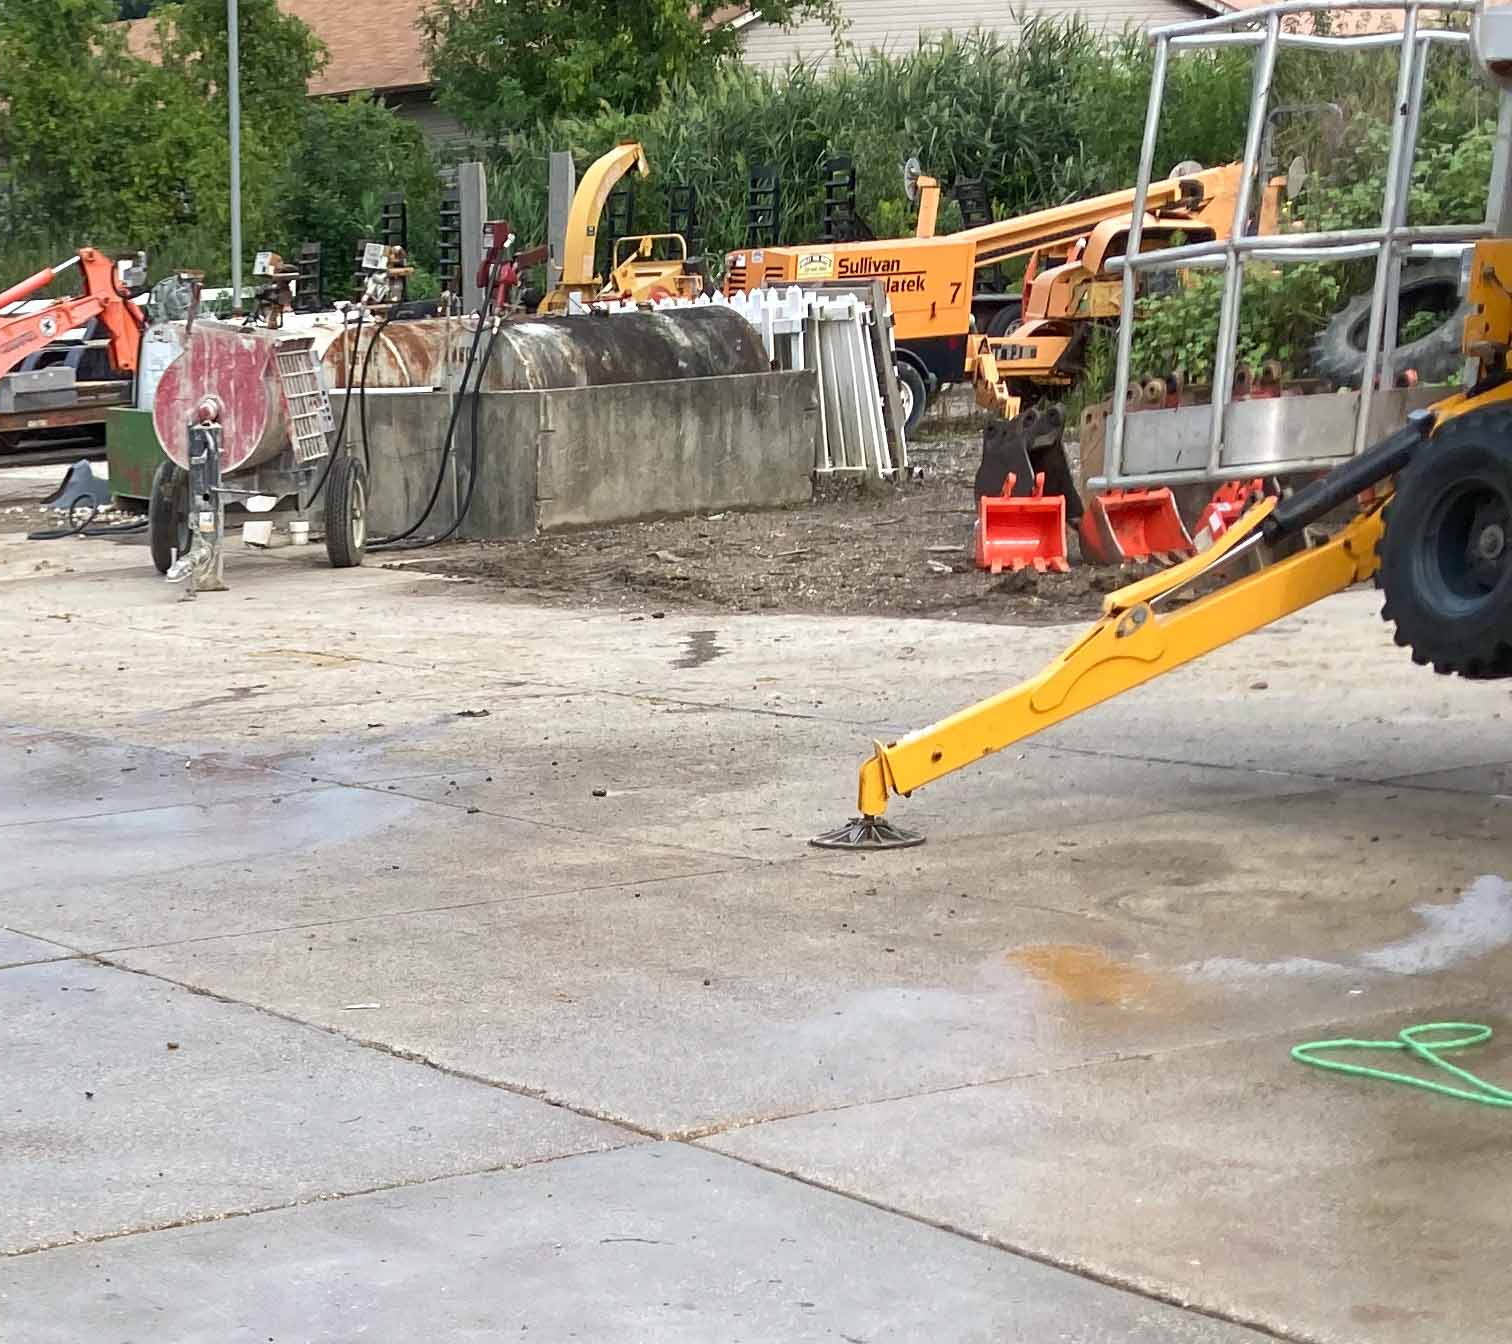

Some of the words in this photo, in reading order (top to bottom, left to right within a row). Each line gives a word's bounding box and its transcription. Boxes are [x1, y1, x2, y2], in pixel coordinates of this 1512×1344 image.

[838, 256, 900, 275] Sullivan
[886, 275, 926, 293] latek
[949, 282, 963, 305] 7
